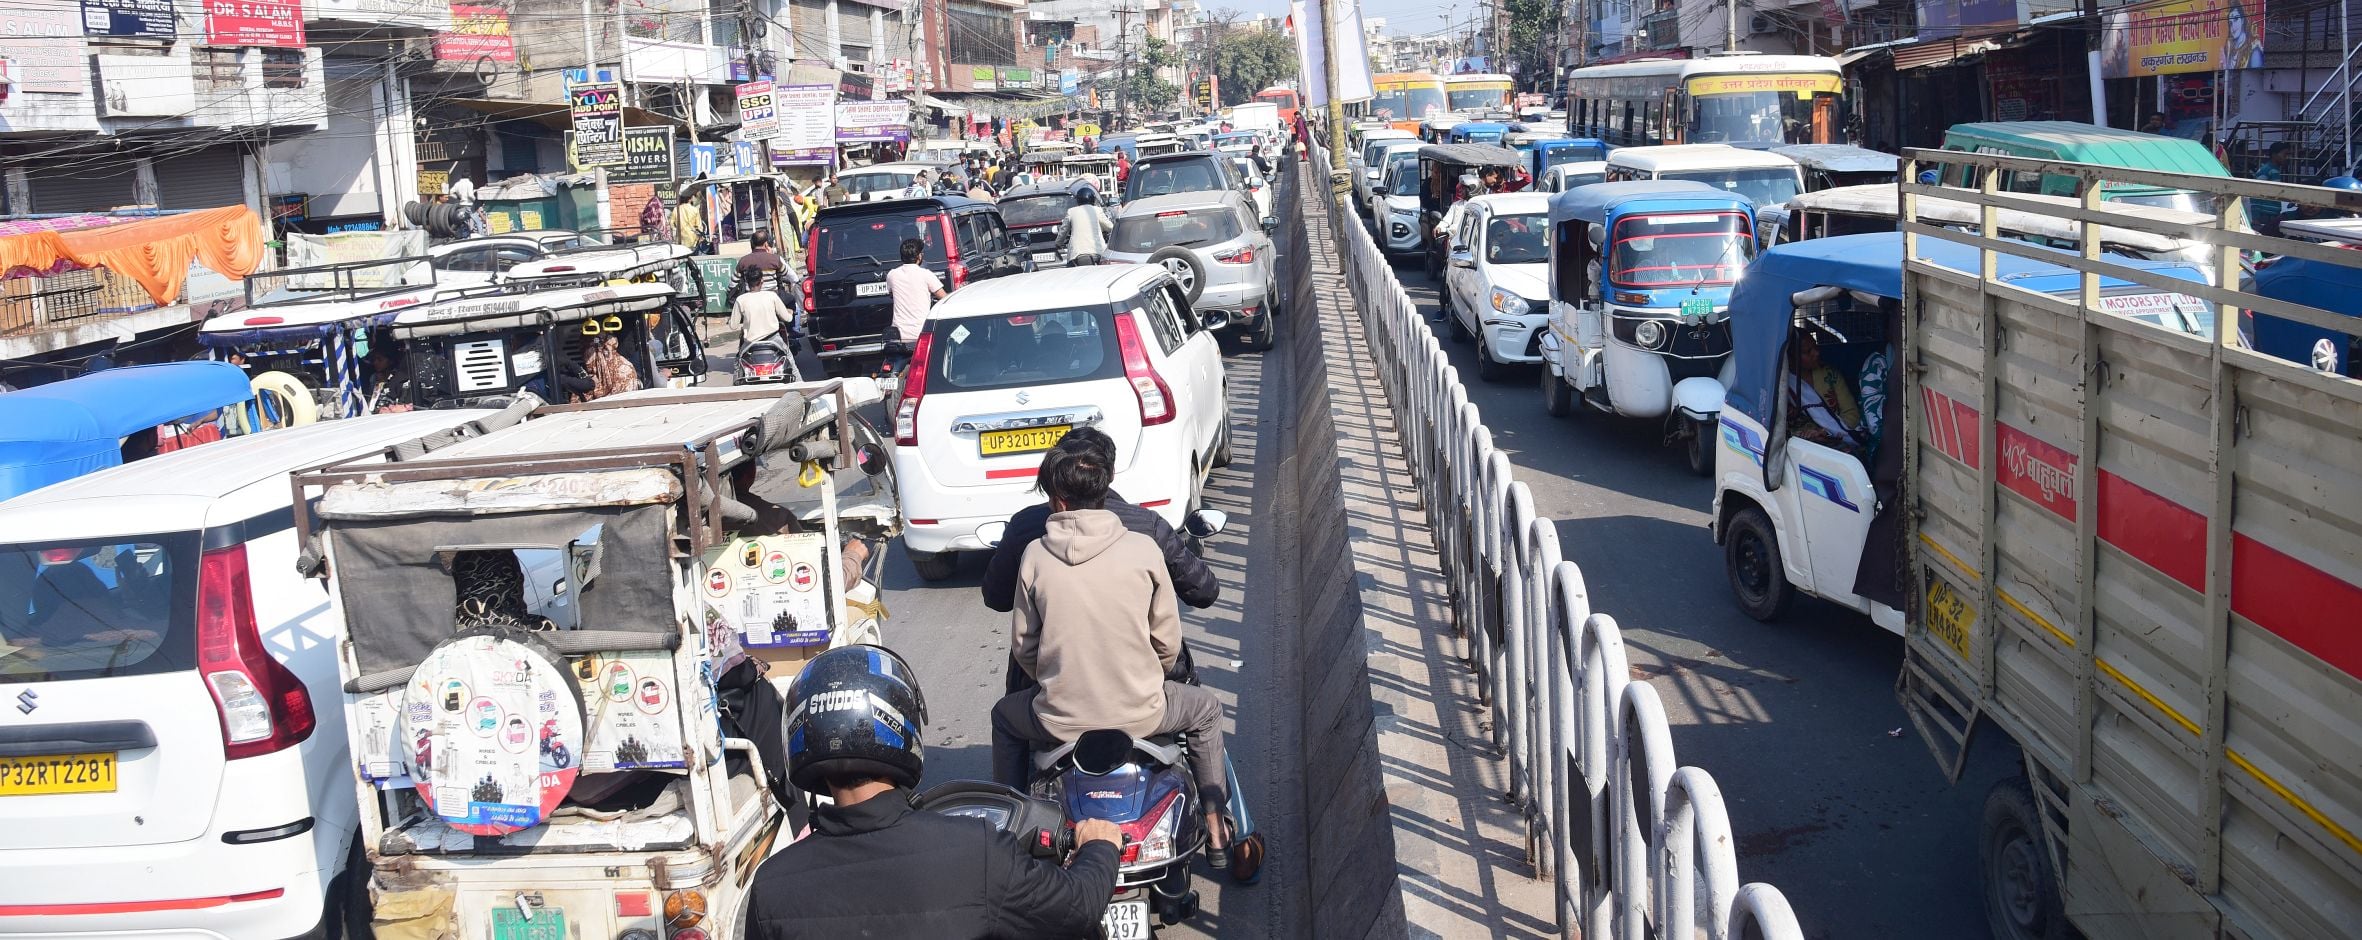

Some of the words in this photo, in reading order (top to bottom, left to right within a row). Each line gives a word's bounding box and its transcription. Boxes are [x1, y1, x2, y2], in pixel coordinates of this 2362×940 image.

[213, 1, 239, 16] DR.
[242, 4, 251, 17] S
[254, 5, 293, 20] ALAM
[24, 22, 69, 37] ALAM
[2177, 51, 2208, 66] लखनऊ
[1720, 79, 1743, 89] उत्तर
[1746, 77, 1773, 89] प्रदेश
[1776, 77, 1816, 89] परिवहन
[573, 91, 618, 106] YUVA
[740, 95, 770, 109] SSC
[575, 104, 592, 113] ADD
[594, 102, 619, 112] POINT
[742, 107, 773, 121] UPP
[628, 154, 668, 165] EOVERS
[2104, 295, 2153, 310] MOTORS
[2002, 437, 2026, 480] MGS
[493, 672, 533, 683] SKYDA
[809, 688, 868, 715] STUDDS
[875, 709, 903, 733] ULTRA
